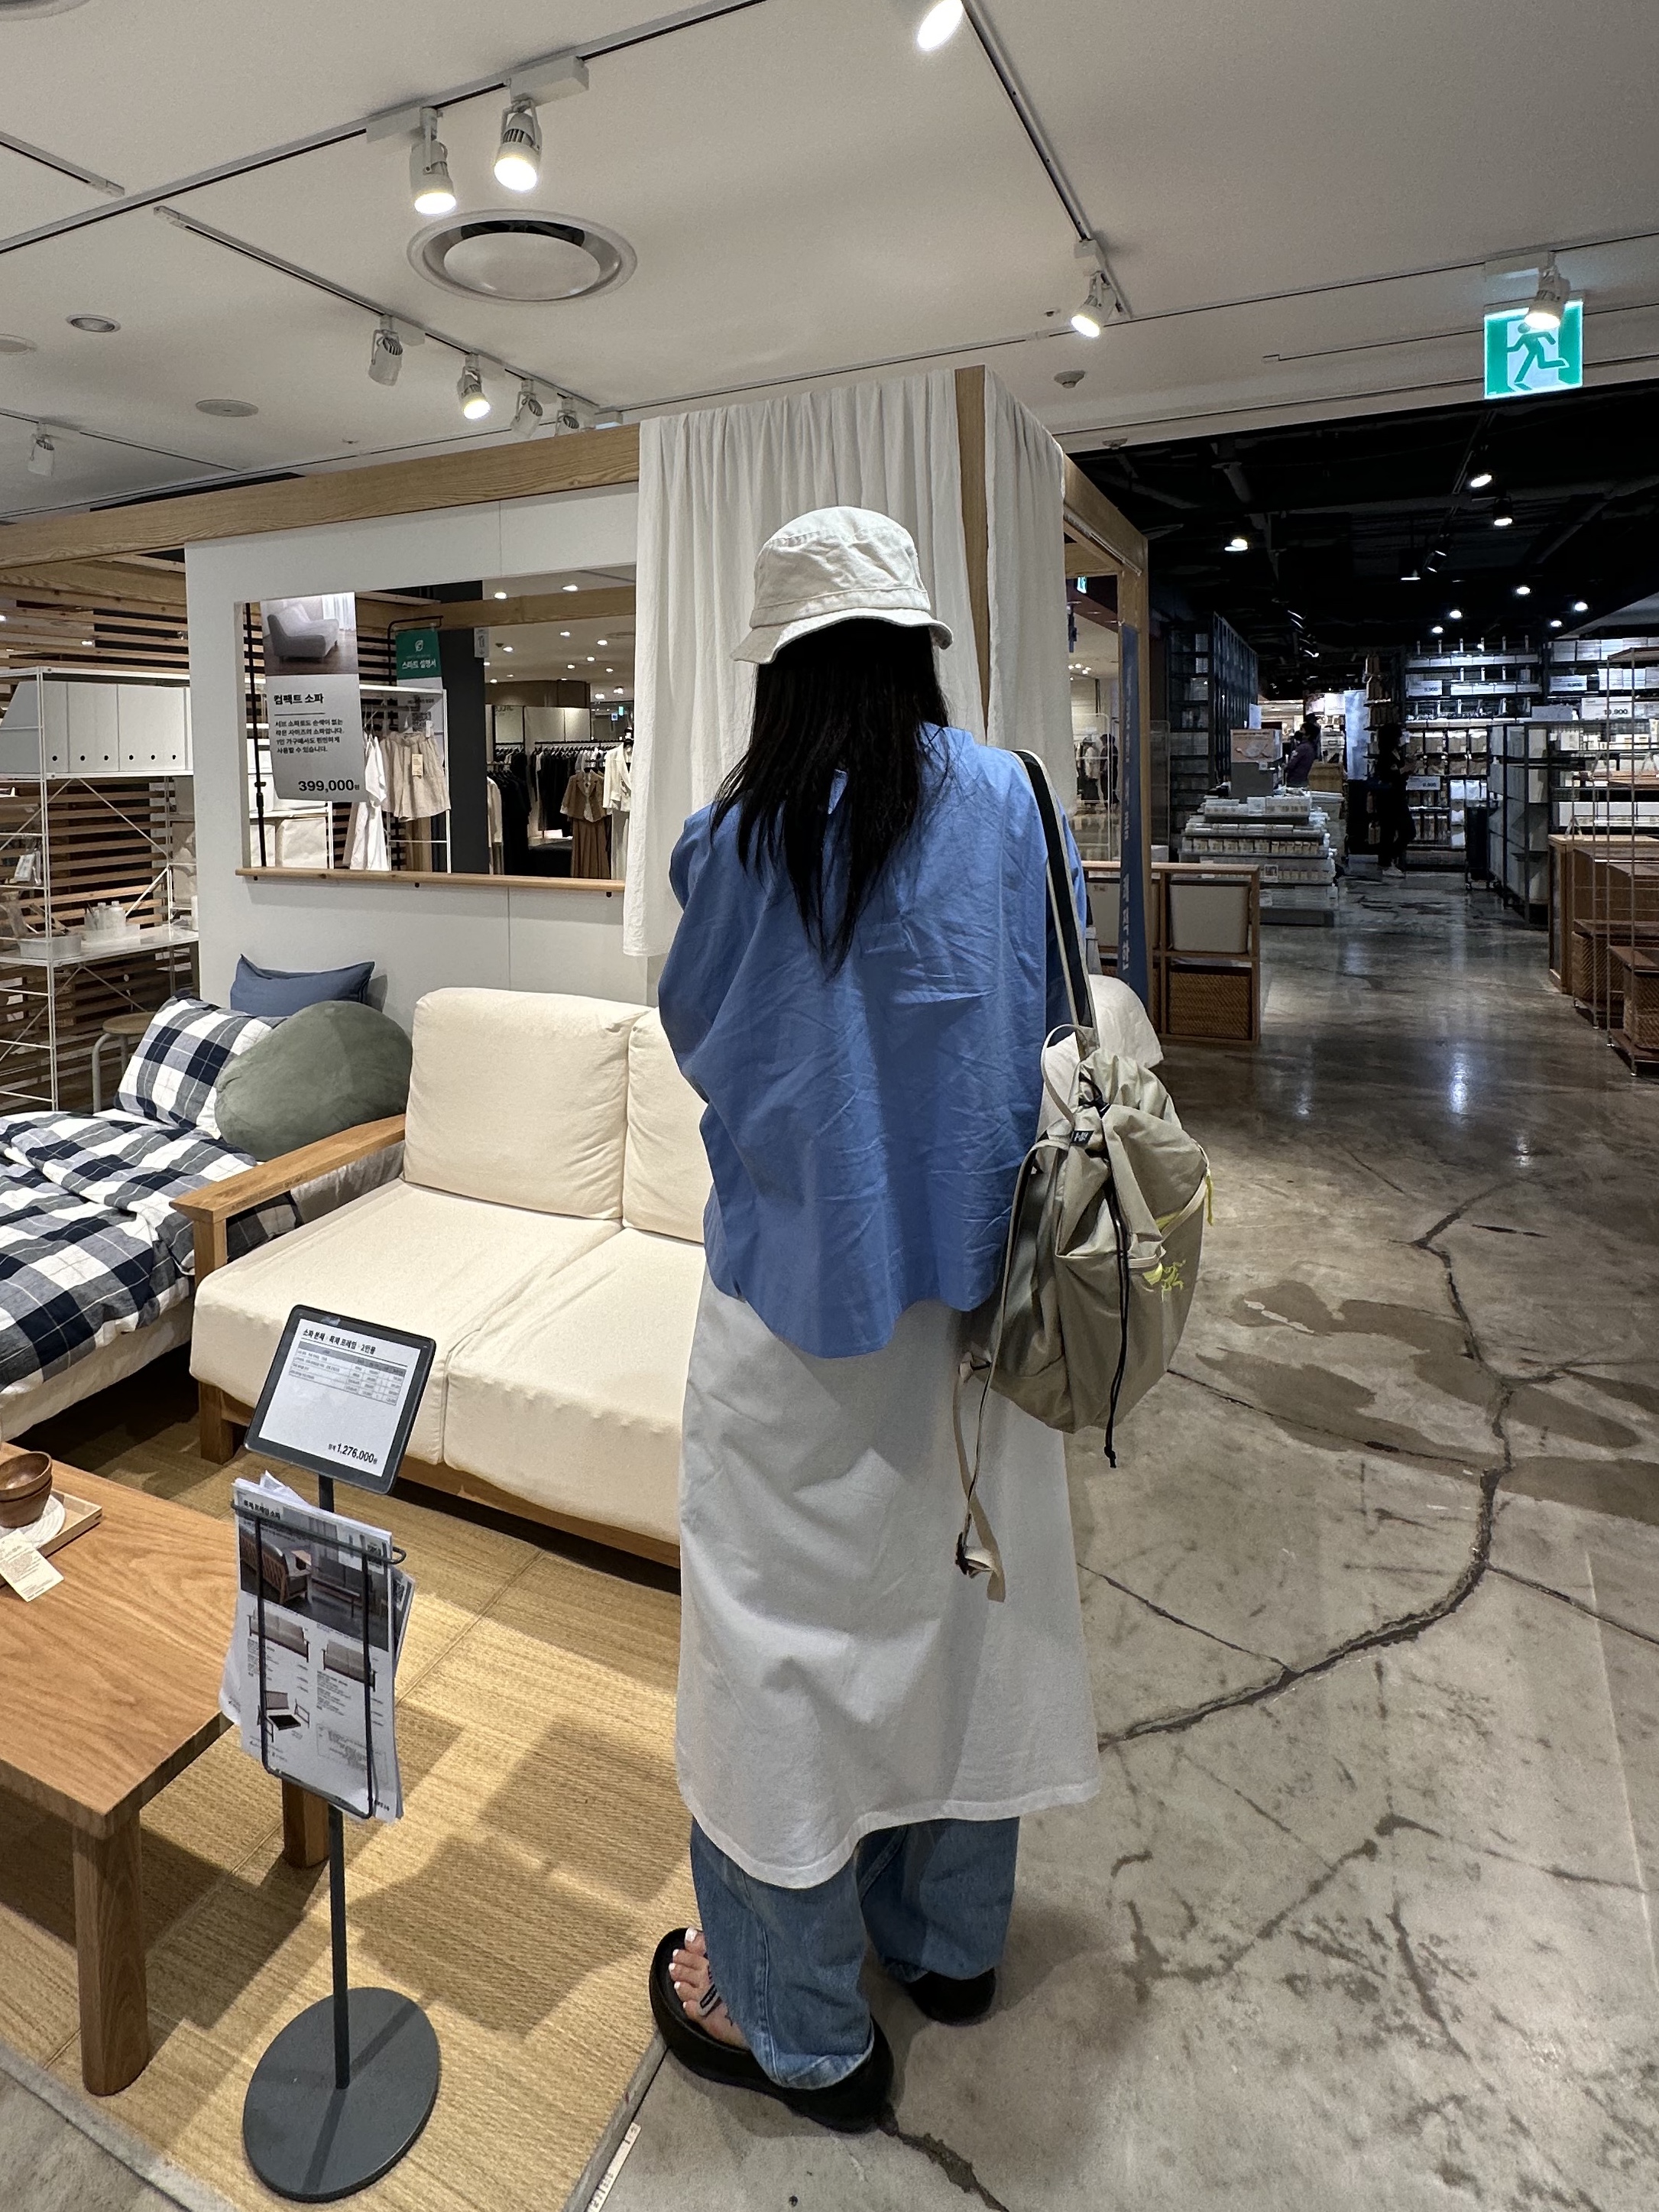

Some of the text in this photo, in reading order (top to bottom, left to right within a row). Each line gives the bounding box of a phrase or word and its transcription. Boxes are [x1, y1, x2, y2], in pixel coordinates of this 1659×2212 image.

[274, 693, 324, 705] 컴팩트 소파
[303, 1328, 313, 1338] 소파
[340, 1338, 358, 1350] 프레임
[360, 1344, 376, 1354] 2인용
